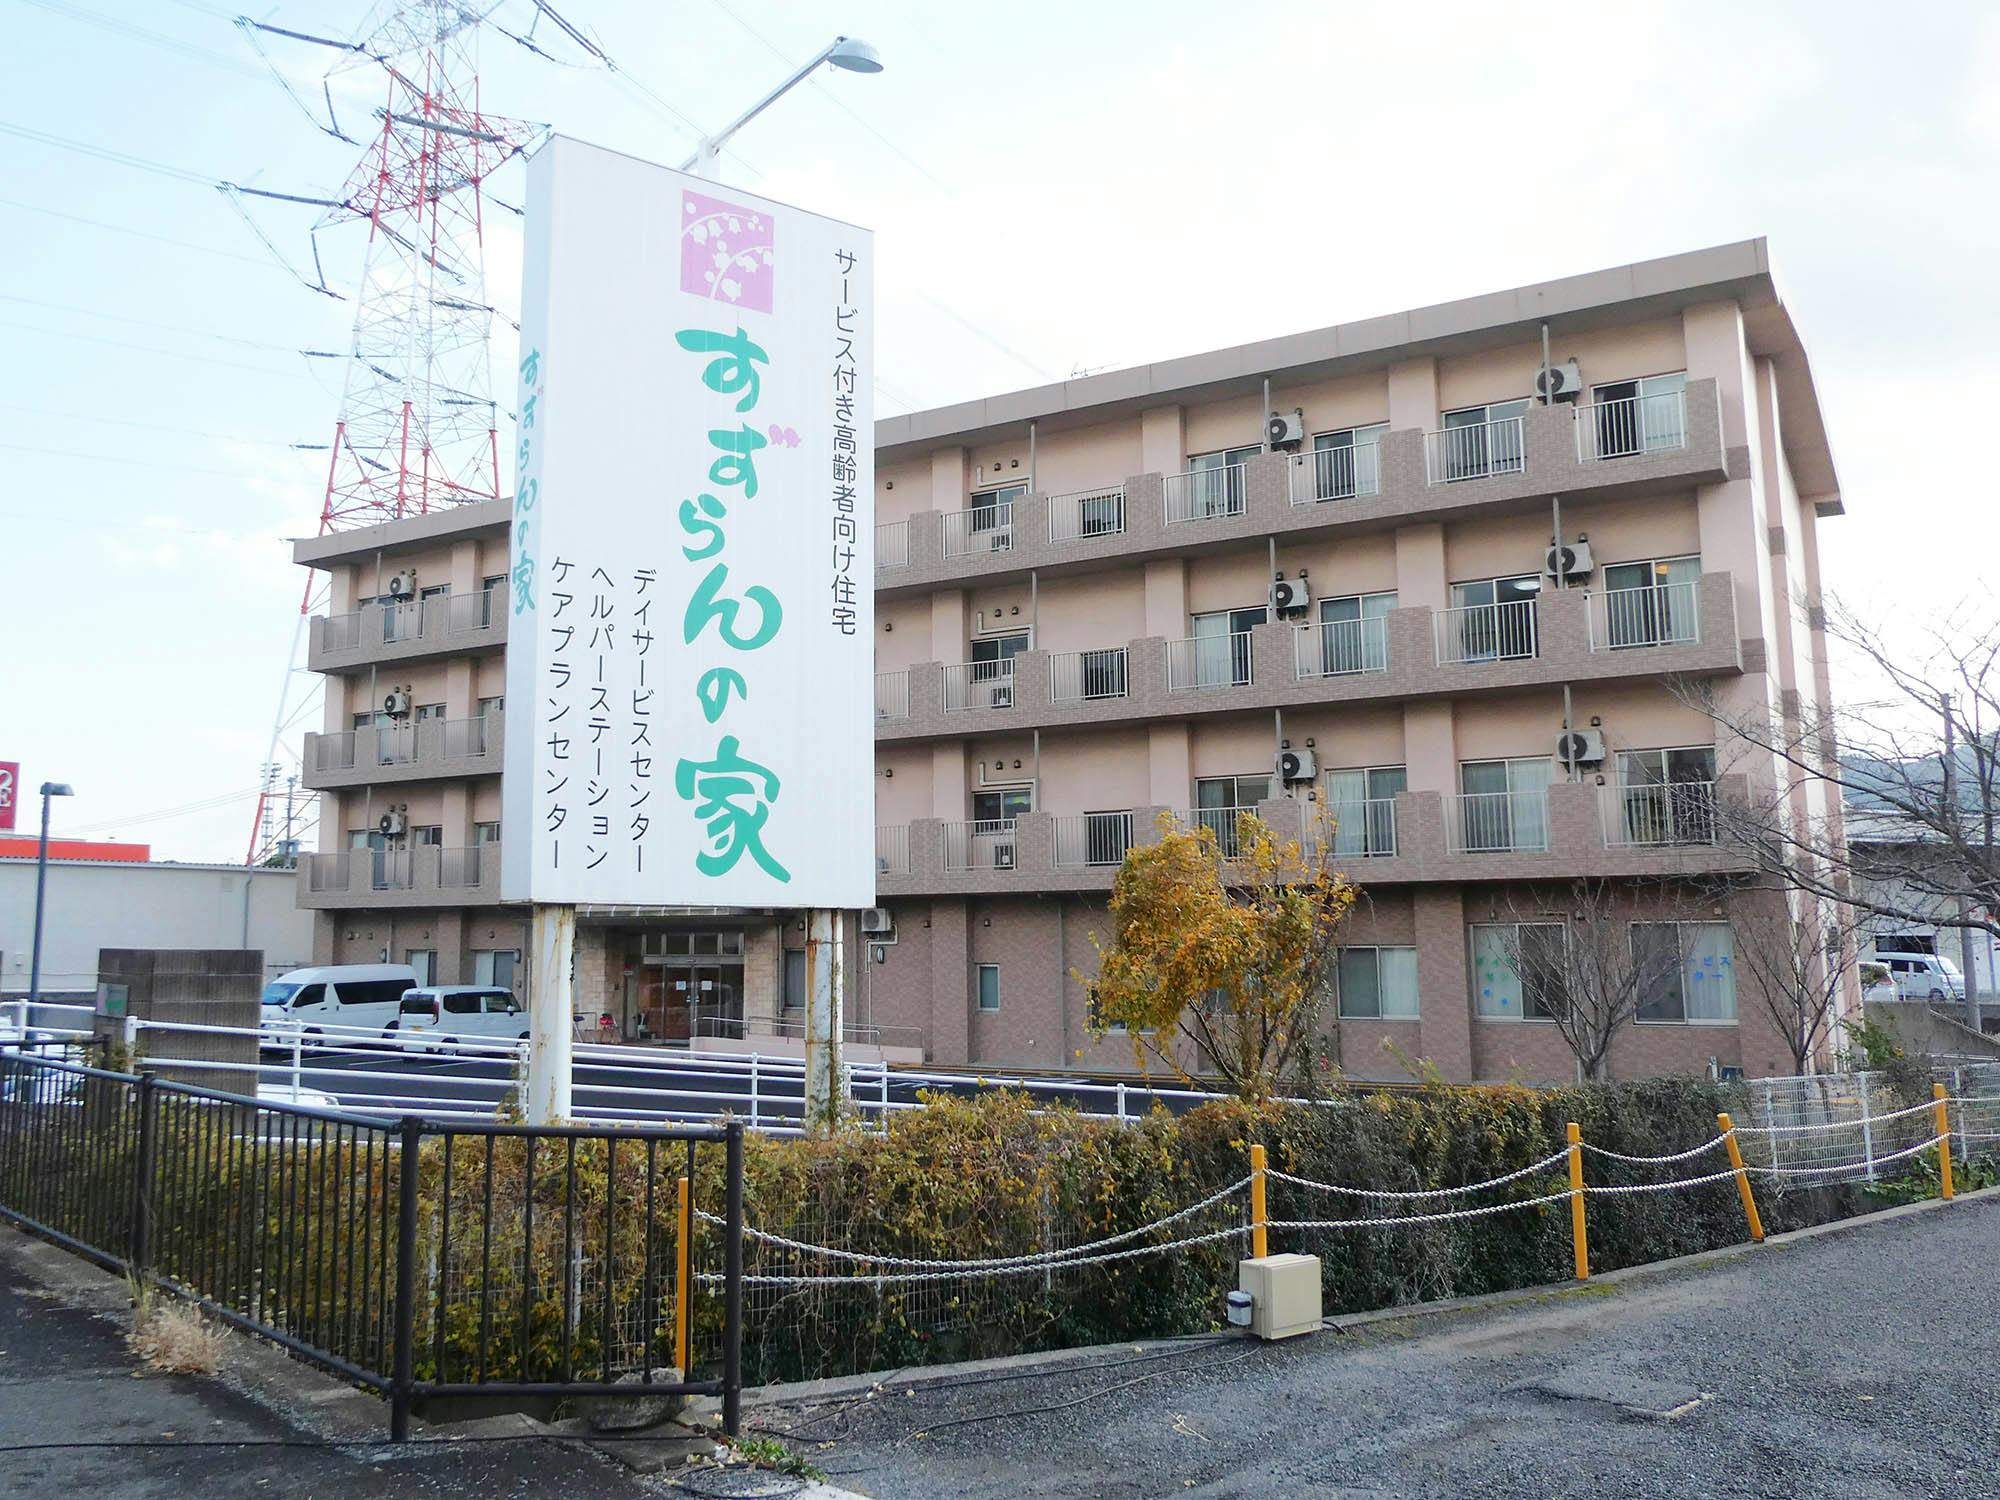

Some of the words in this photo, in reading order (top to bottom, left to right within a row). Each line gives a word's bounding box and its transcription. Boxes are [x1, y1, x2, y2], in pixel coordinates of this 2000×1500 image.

[832, 249, 858, 635] サービス付き高齢者向け住宅
[546, 556, 576, 869] ケアプランセンター
[586, 567, 615, 870] ヘルパーステーション
[630, 569, 657, 873] デイサービスセンター
[676, 328, 803, 883] すずらんの家
